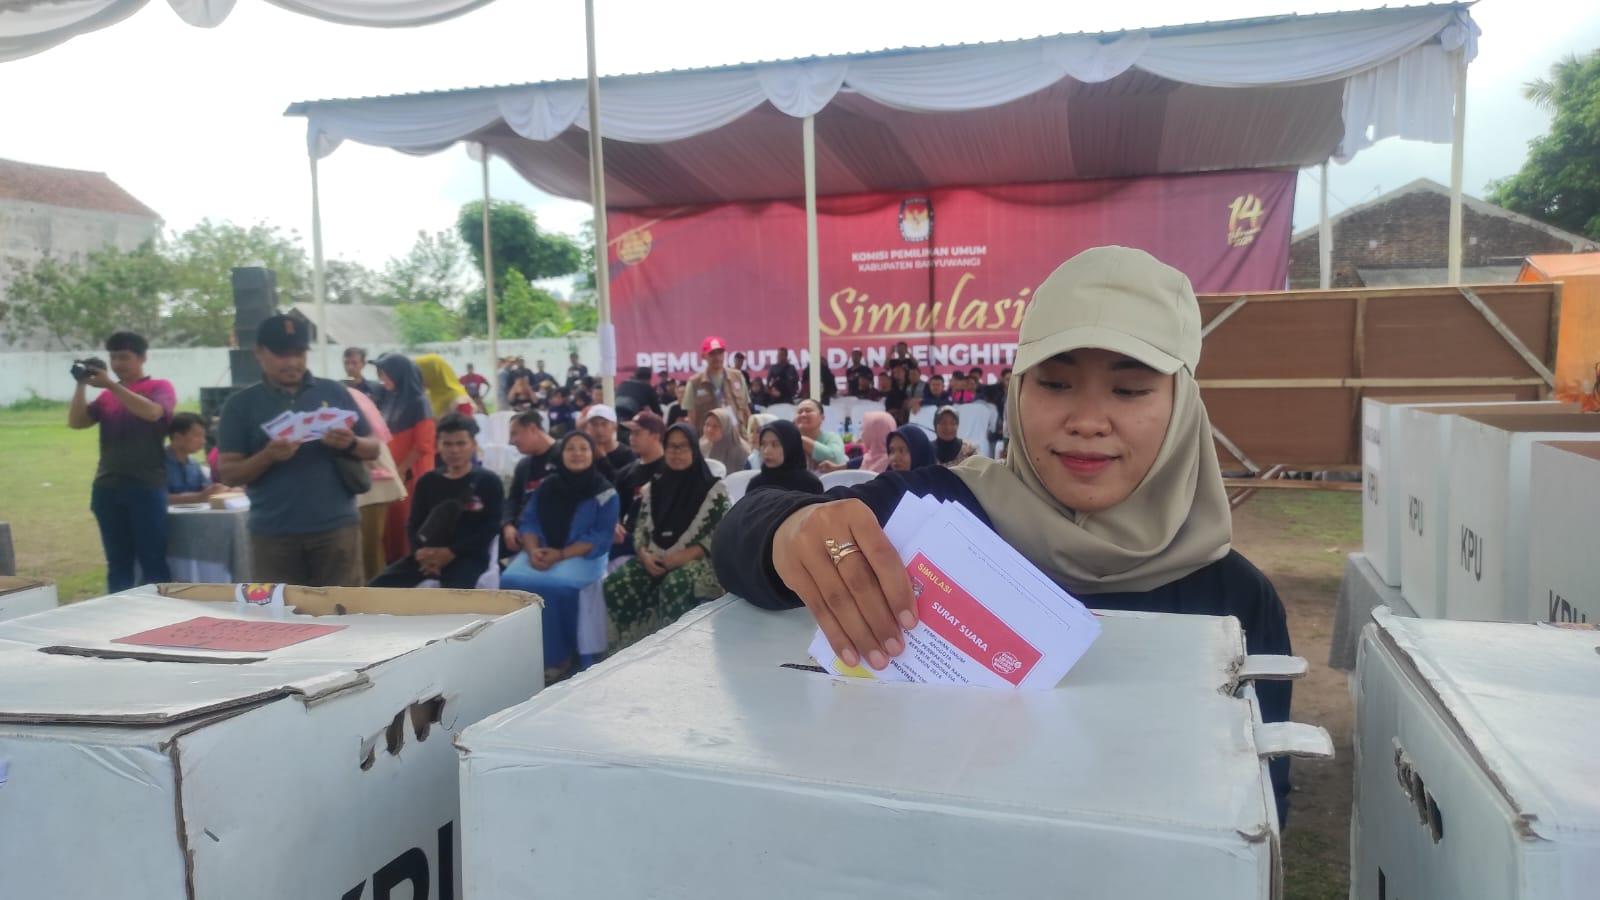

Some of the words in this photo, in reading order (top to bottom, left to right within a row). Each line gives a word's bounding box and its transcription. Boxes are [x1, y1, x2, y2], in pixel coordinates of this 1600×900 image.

[852, 252, 888, 262] KOMISI
[950, 245, 987, 257] UMUM
[858, 261, 913, 272] KABUPATEN
[819, 272, 1031, 336] Simulasi
[1408, 495, 1424, 537] KPU
[1461, 524, 1483, 582] KPU
[917, 563, 952, 594] SIMULASI
[931, 601, 961, 627] SURAT
[959, 624, 989, 652] SUARA
